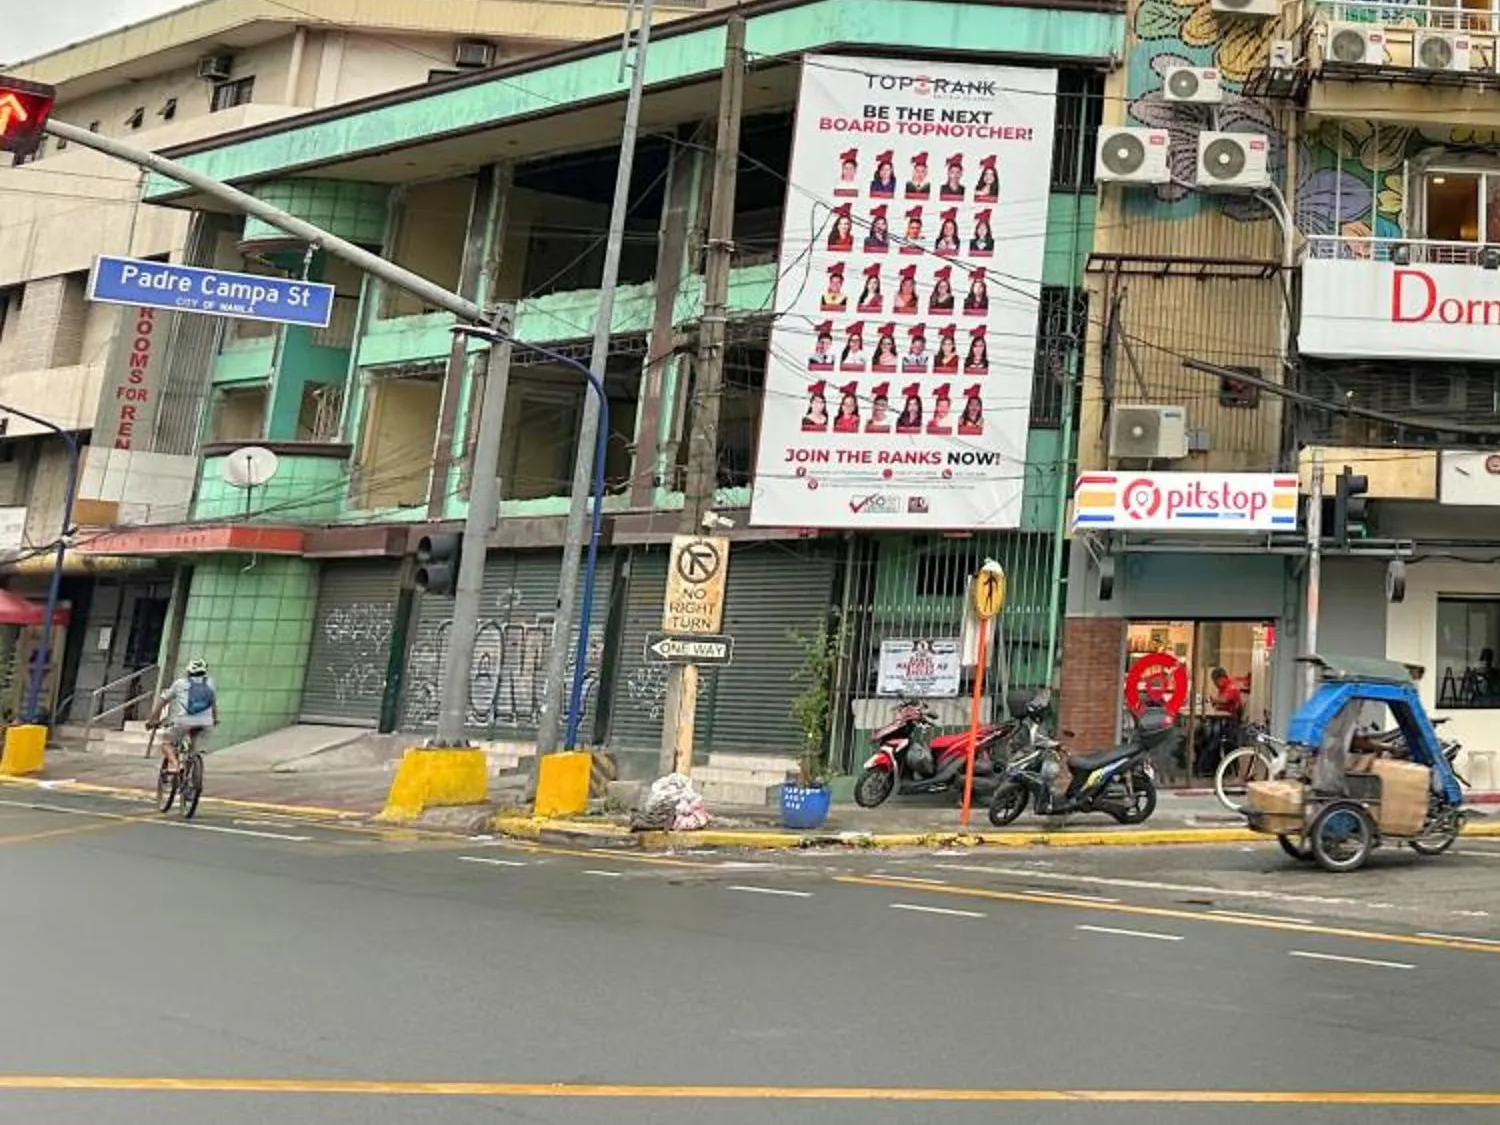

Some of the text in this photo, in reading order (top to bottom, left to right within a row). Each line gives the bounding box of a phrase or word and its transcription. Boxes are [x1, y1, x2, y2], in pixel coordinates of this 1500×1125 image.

[865, 74, 996, 96] TOP RANK
[863, 104, 993, 124] BE THE NEXT
[819, 117, 1033, 140] BOARD TOPNOTCHER!
[121, 265, 310, 307] Padre Campa St
[176, 297, 255, 313] CITY OF MANILA
[128, 306, 153, 384] ROOMS
[116, 386, 148, 402] FOR
[784, 448, 1001, 466] JOIN THE RANKS NOW!
[1167, 480, 1267, 521] pitstop
[683, 588, 707, 600] NO
[669, 602, 715, 615] RIGHT
[671, 616, 711, 629] TURN
[660, 642, 725, 655] ONE WAY
